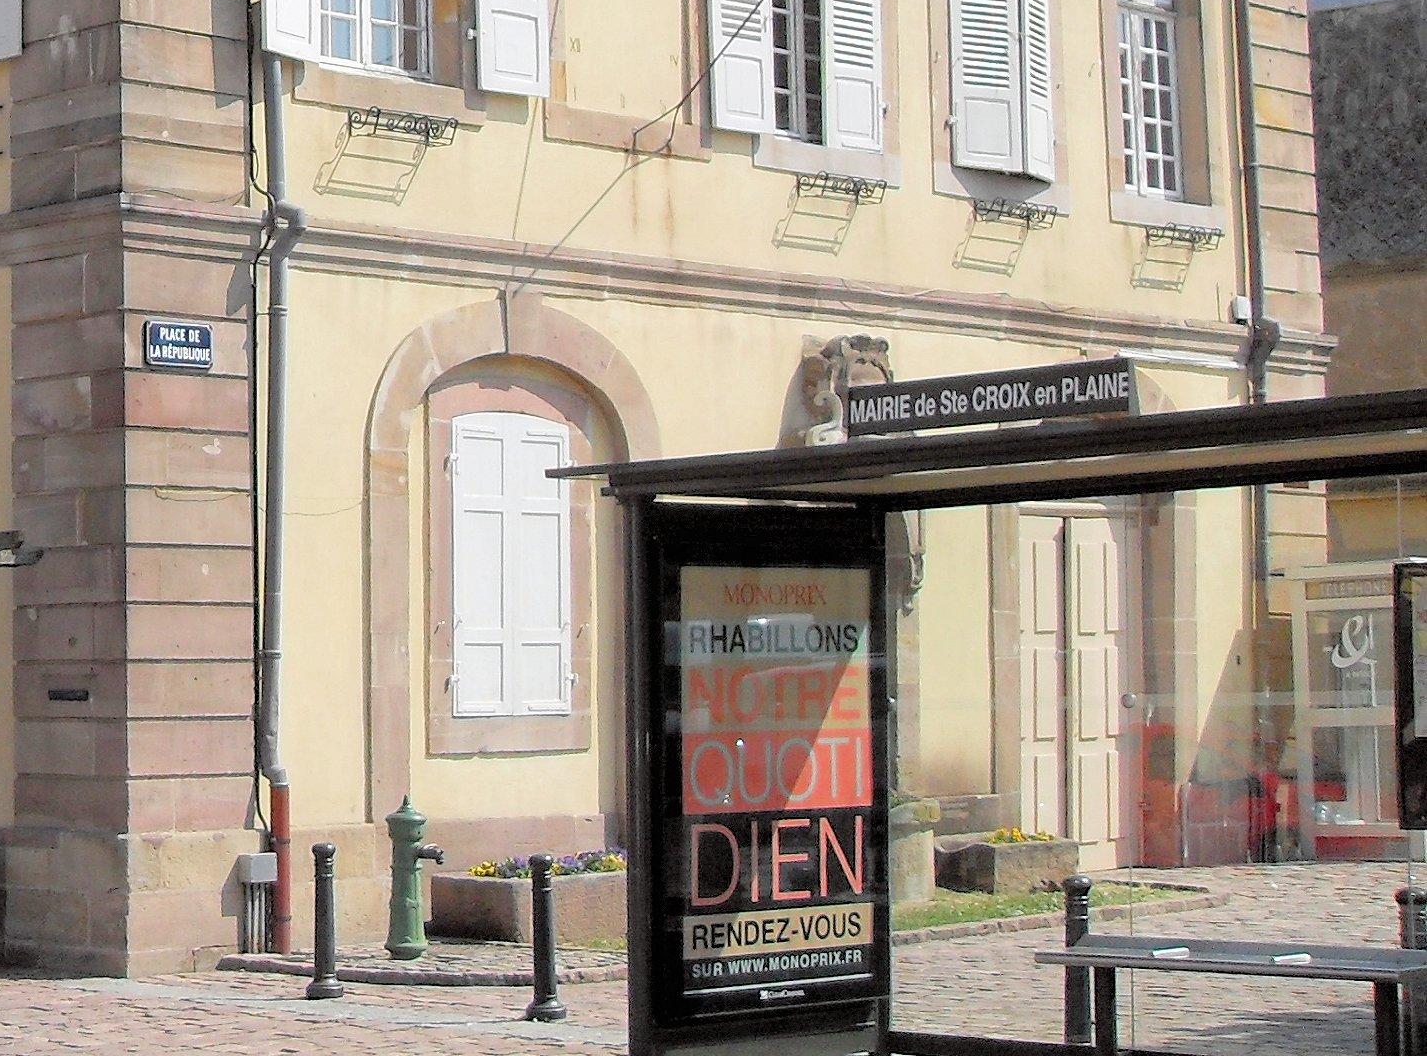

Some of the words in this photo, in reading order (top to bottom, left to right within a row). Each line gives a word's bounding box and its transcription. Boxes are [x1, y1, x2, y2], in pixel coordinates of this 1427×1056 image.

[150, 344, 161, 358] LA
[162, 343, 211, 361] RÉPUBLIQUE
[159, 327, 186, 342] PLACE
[188, 329, 200, 343] DE
[850, 394, 911, 424] MAIRIE
[914, 393, 936, 417] de
[940, 390, 968, 415] Ste
[972, 382, 1031, 412] CROIX
[1035, 384, 1056, 405] en
[1061, 372, 1130, 403] PLAINE
[723, 583, 827, 606] MONOPRIX
[690, 624, 859, 653] RHABILLONS
[688, 665, 862, 724] NOTRE
[689, 736, 864, 807] QUOTI
[690, 815, 865, 907] DIEN
[692, 911, 862, 951] RENDEZ-VOUS
[692, 962, 723, 978] SUR
[728, 949, 862, 975] WWW.MONOPRIX.FR
